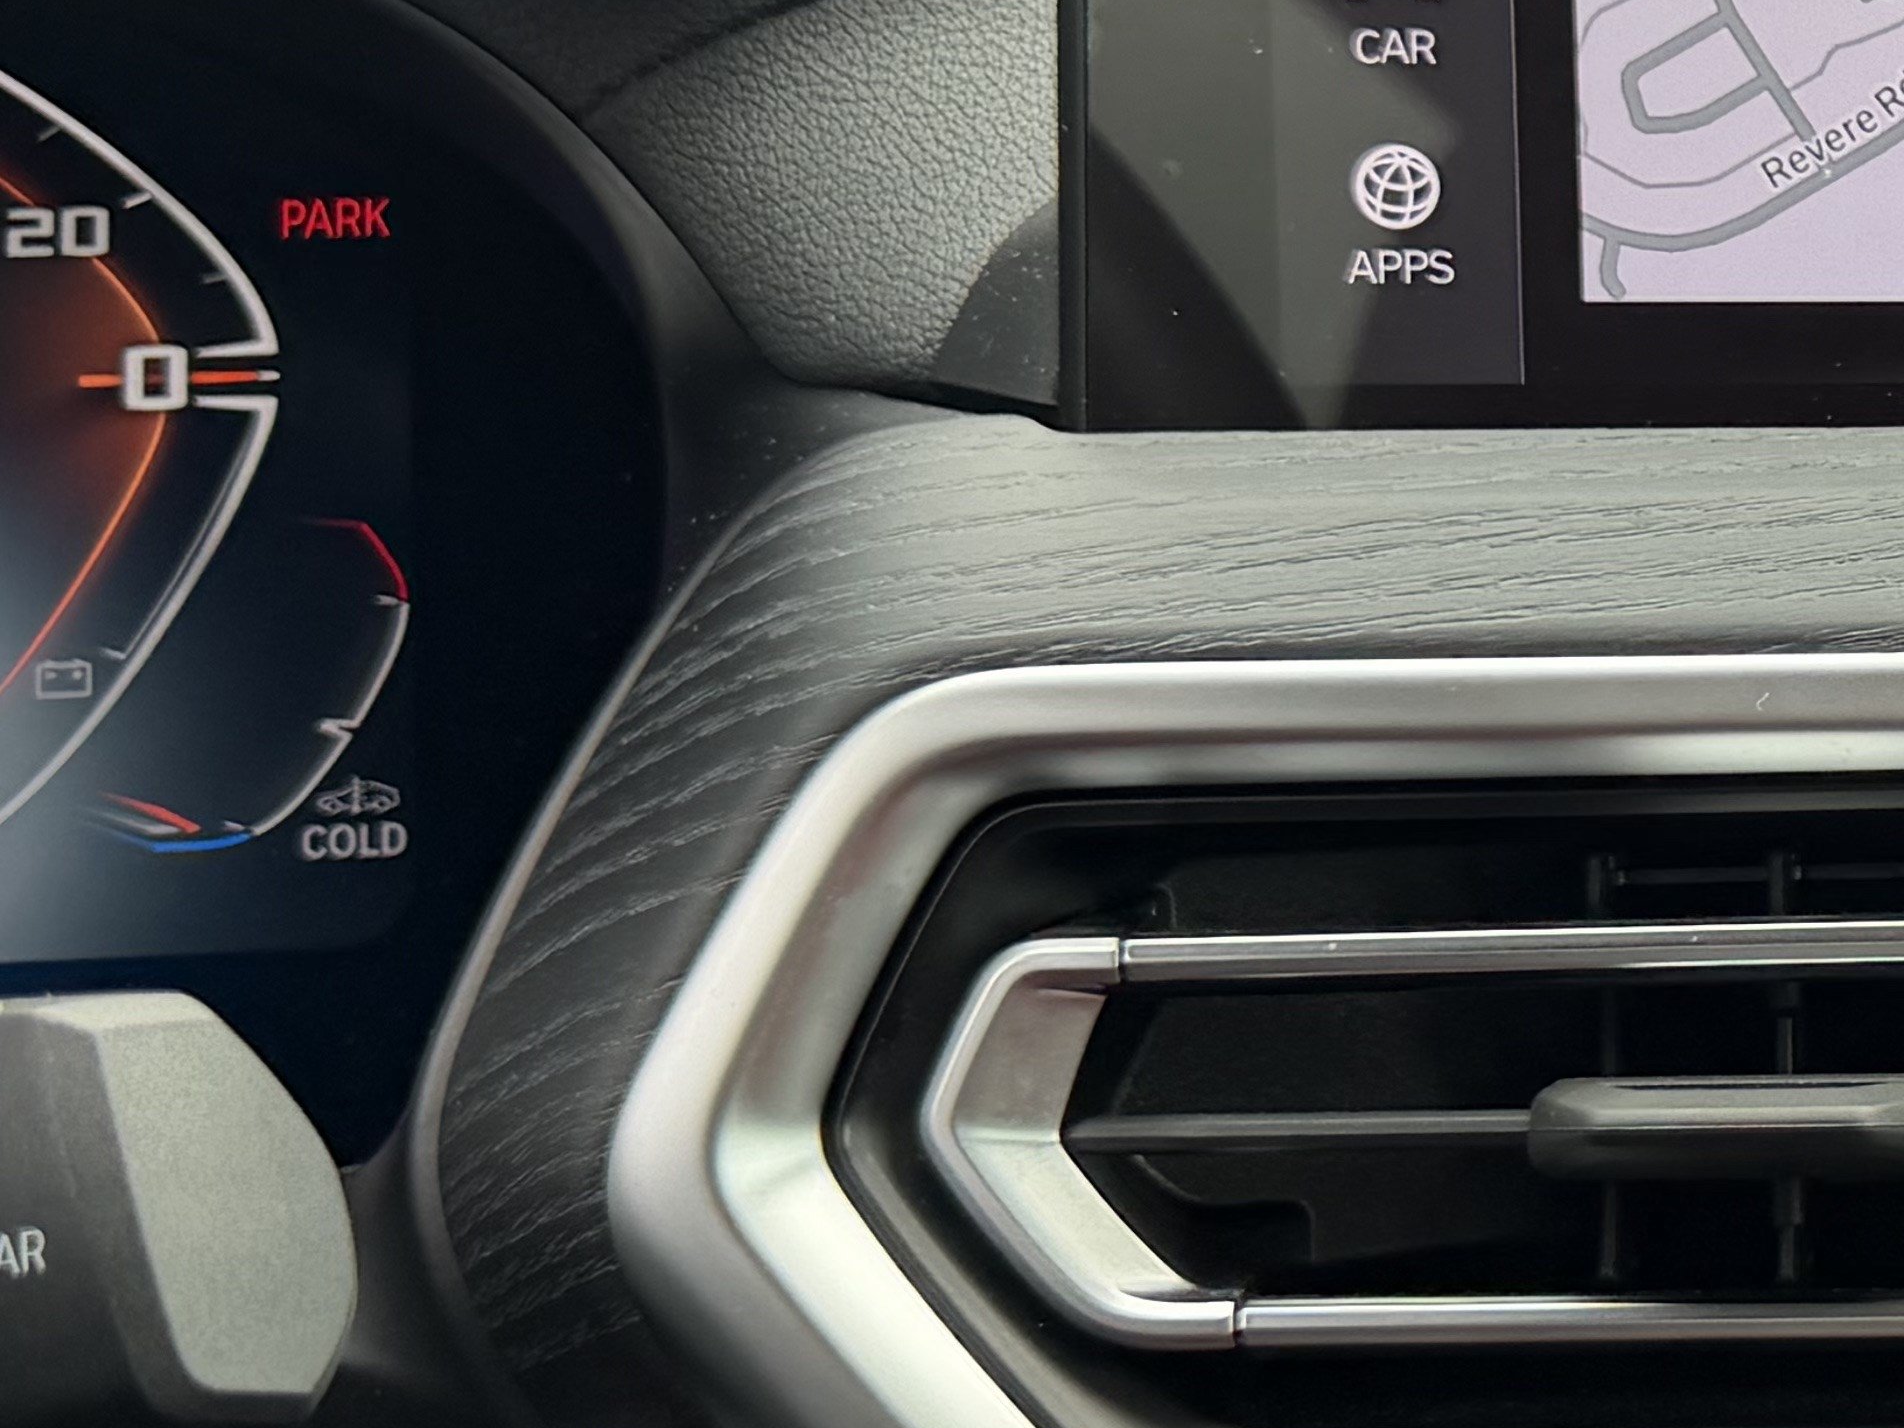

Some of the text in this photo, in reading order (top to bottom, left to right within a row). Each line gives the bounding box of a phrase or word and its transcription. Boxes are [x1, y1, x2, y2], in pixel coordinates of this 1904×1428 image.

[1348, 26, 1438, 66] CAR
[1760, 114, 1866, 189] Revere
[6, 204, 110, 258] 20
[280, 196, 392, 240] PARK
[1345, 248, 1456, 288] APPS
[123, 345, 188, 410] 0
[302, 822, 408, 859] COLD
